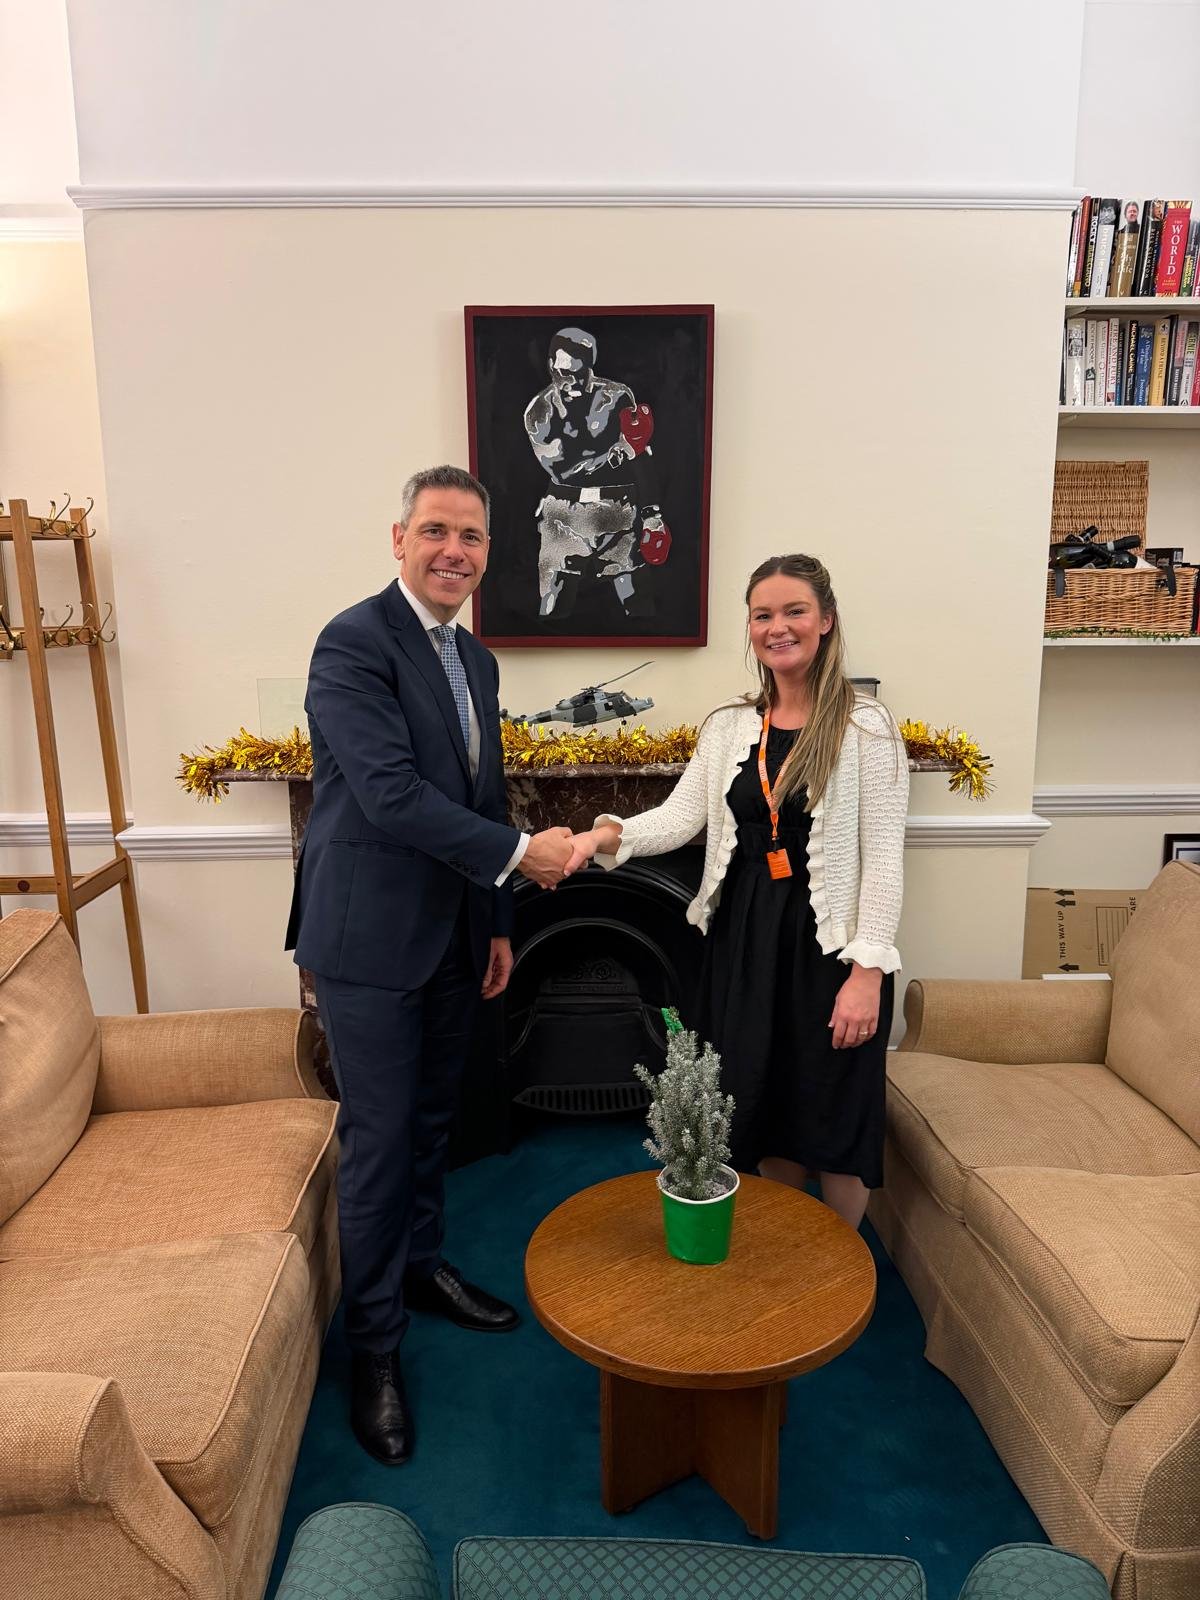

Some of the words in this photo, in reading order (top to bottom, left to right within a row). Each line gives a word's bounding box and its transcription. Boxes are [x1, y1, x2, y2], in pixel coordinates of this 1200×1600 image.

[1089, 215, 1099, 242] ROCKY
[1166, 224, 1183, 275] WORLD
[1129, 323, 1137, 352] MICHAEL
[1159, 337, 1167, 356] BEYOND
[1127, 353, 1135, 373] CAINE
[1157, 361, 1165, 379] FRINGE
[1057, 910, 1064, 921] UP
[1129, 896, 1137, 916] ARE
[1058, 923, 1066, 940] WAY
